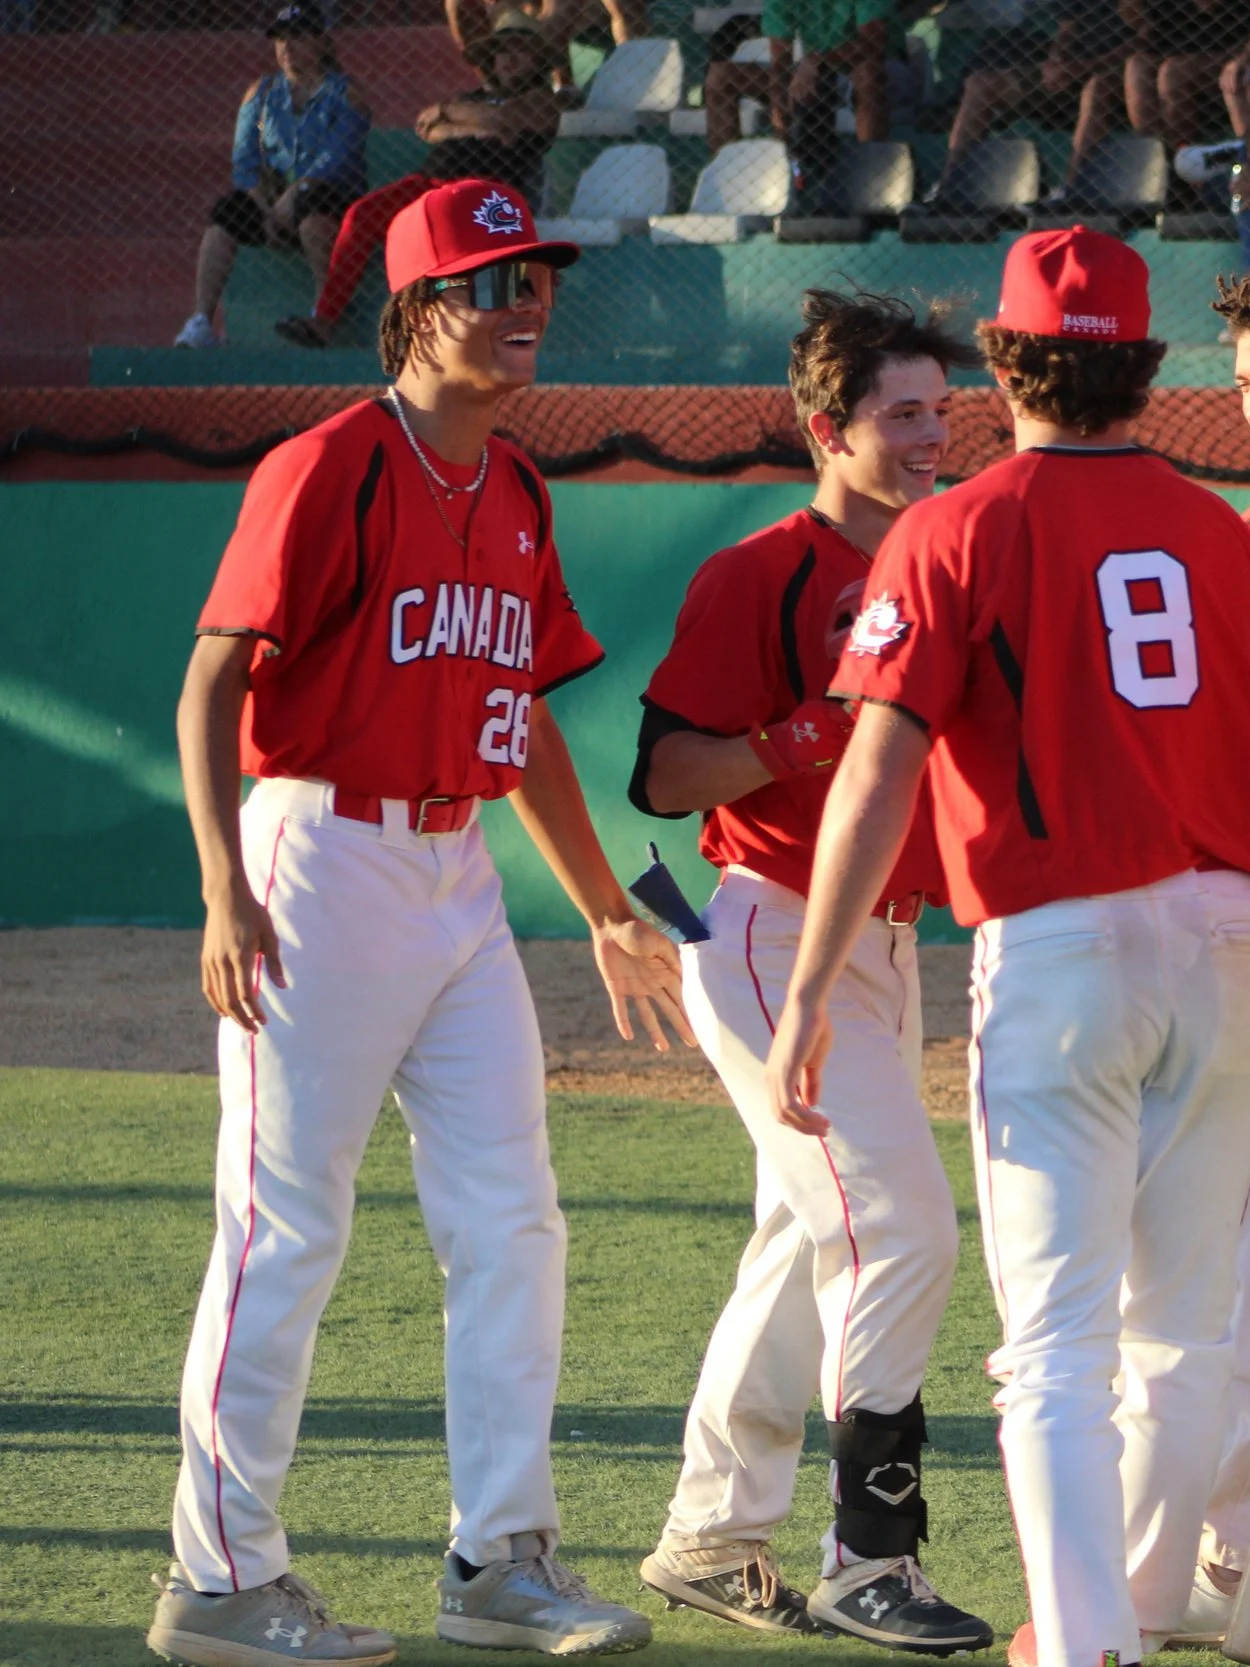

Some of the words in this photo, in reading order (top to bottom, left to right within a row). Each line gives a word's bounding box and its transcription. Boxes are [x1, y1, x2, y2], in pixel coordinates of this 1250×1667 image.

[1063, 314, 1118, 328] BASEBALL
[390, 581, 534, 674] CANADA
[1096, 549, 1200, 709] 8
[476, 687, 533, 769] 28
